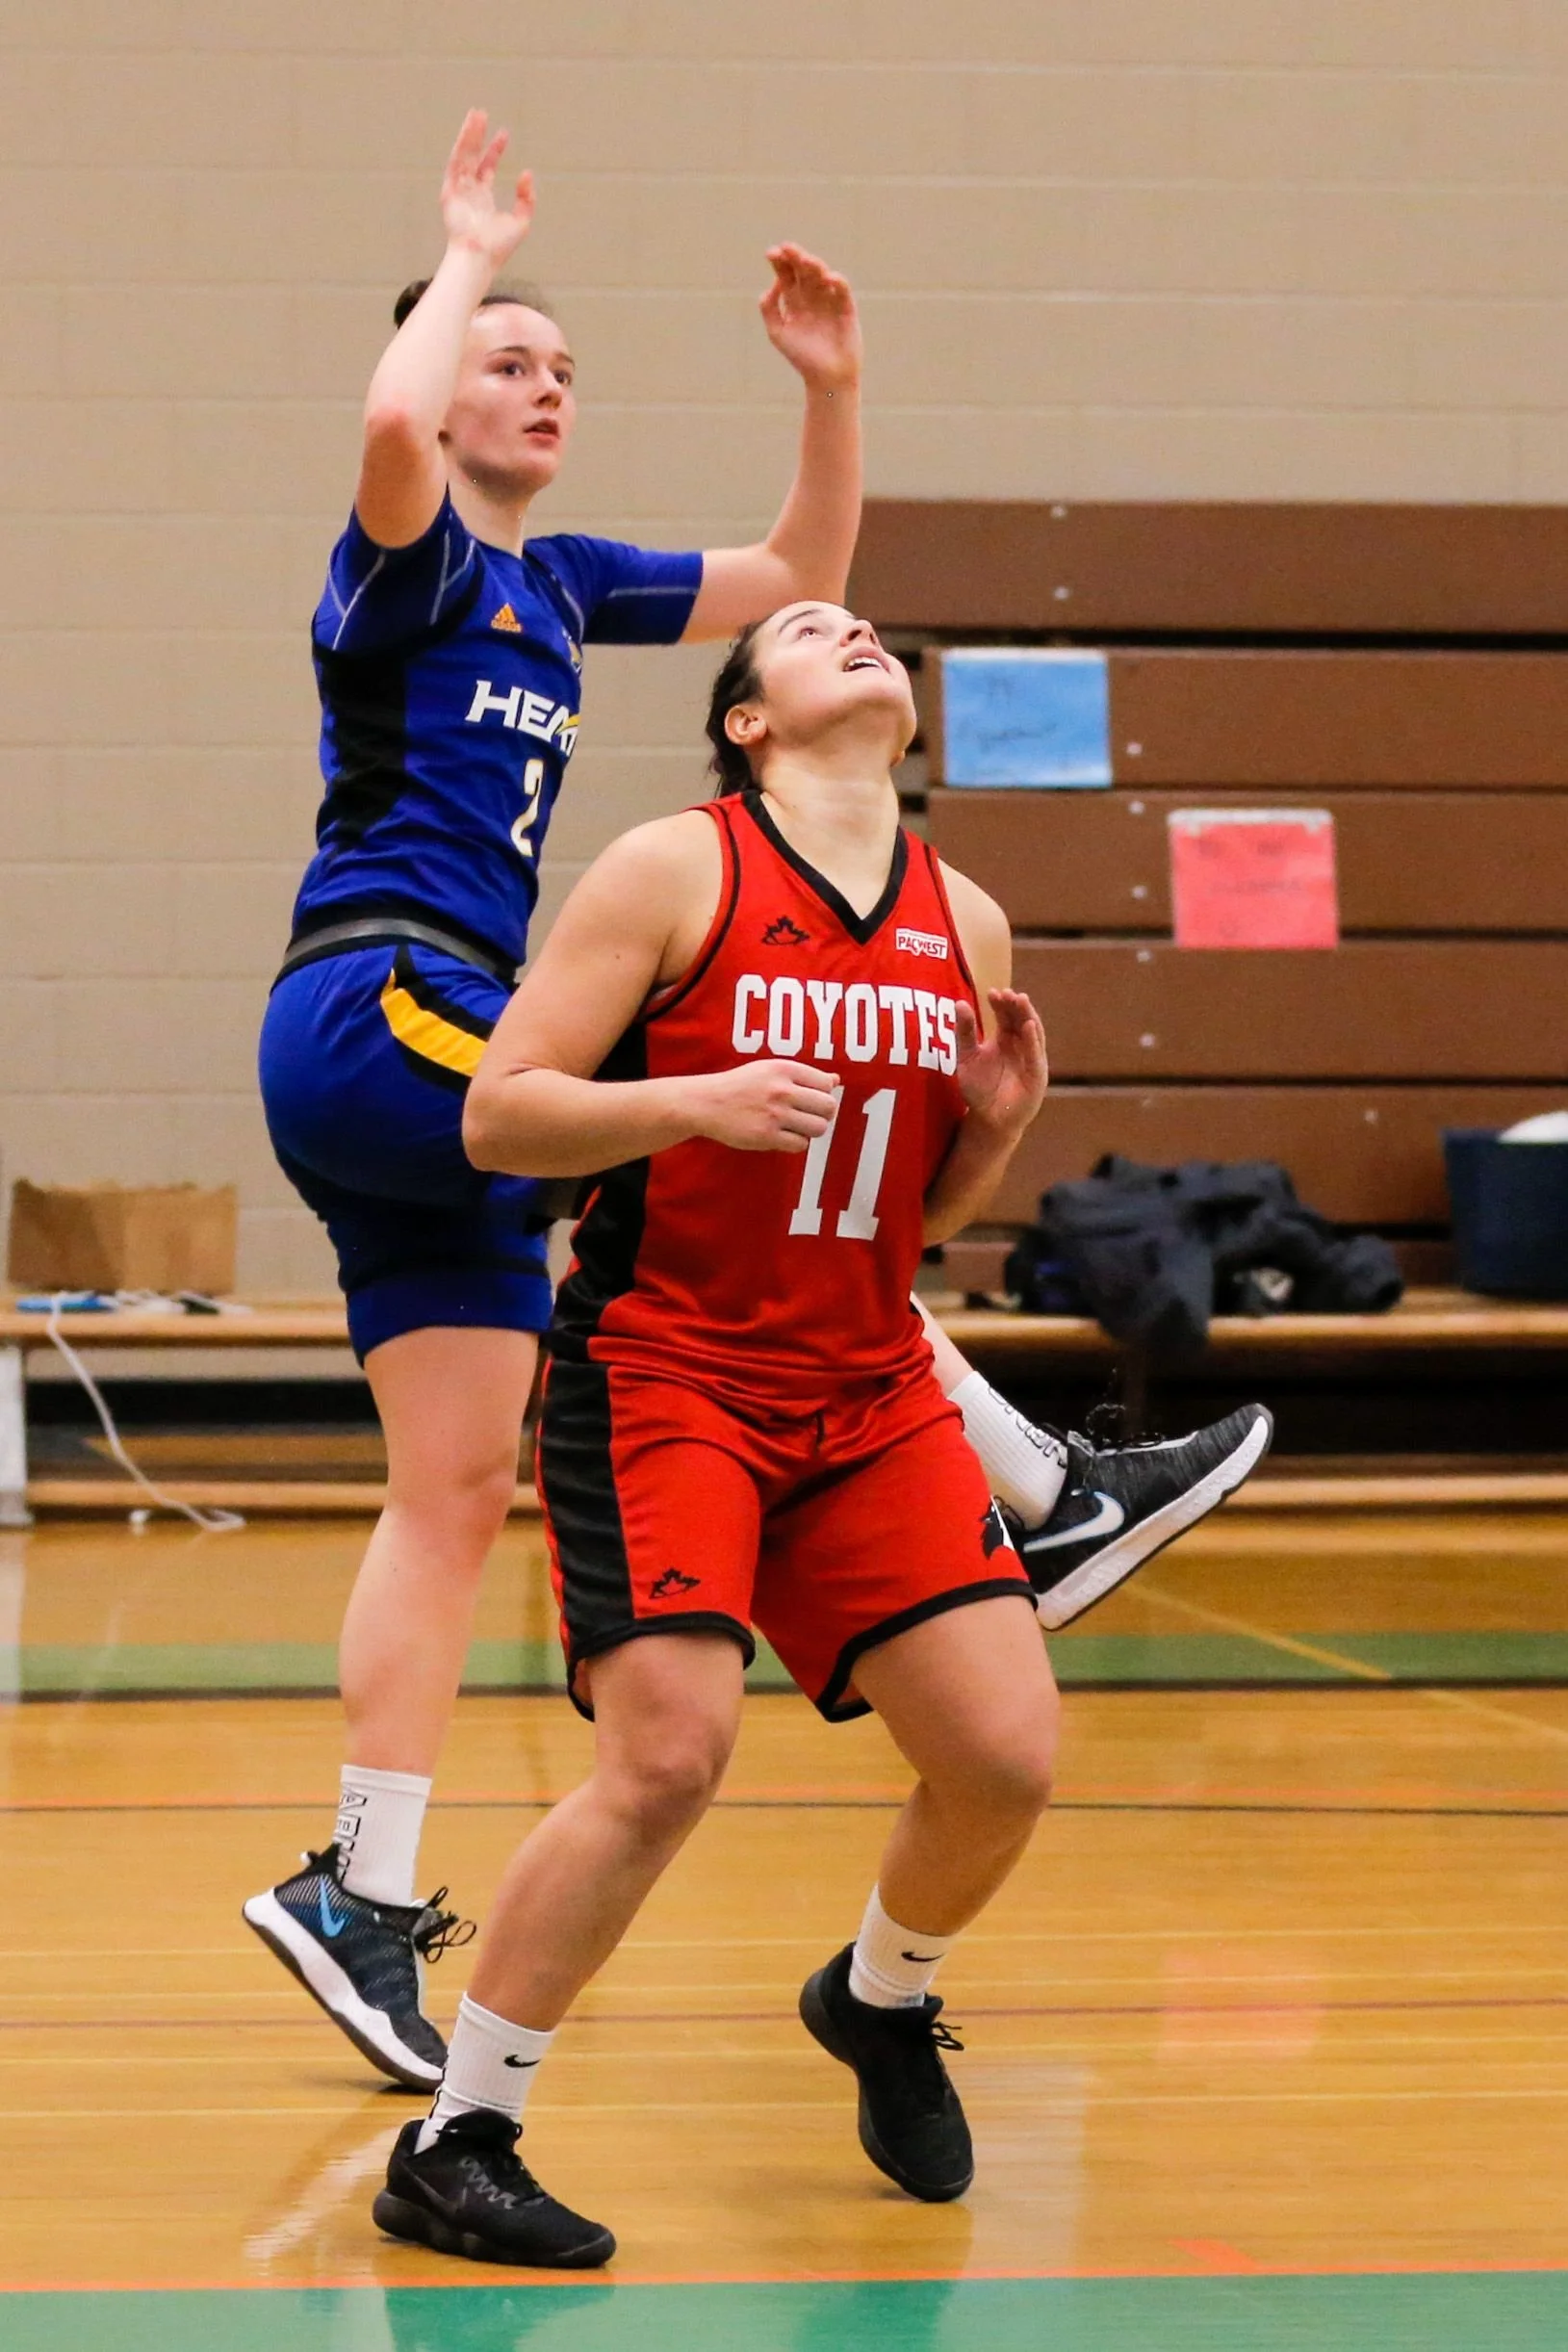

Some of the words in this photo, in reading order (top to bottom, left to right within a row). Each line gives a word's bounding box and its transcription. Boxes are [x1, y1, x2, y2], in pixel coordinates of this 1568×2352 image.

[510, 759, 544, 857] 2
[732, 973, 957, 1076] COYOTES
[788, 1084, 896, 1241] 11
